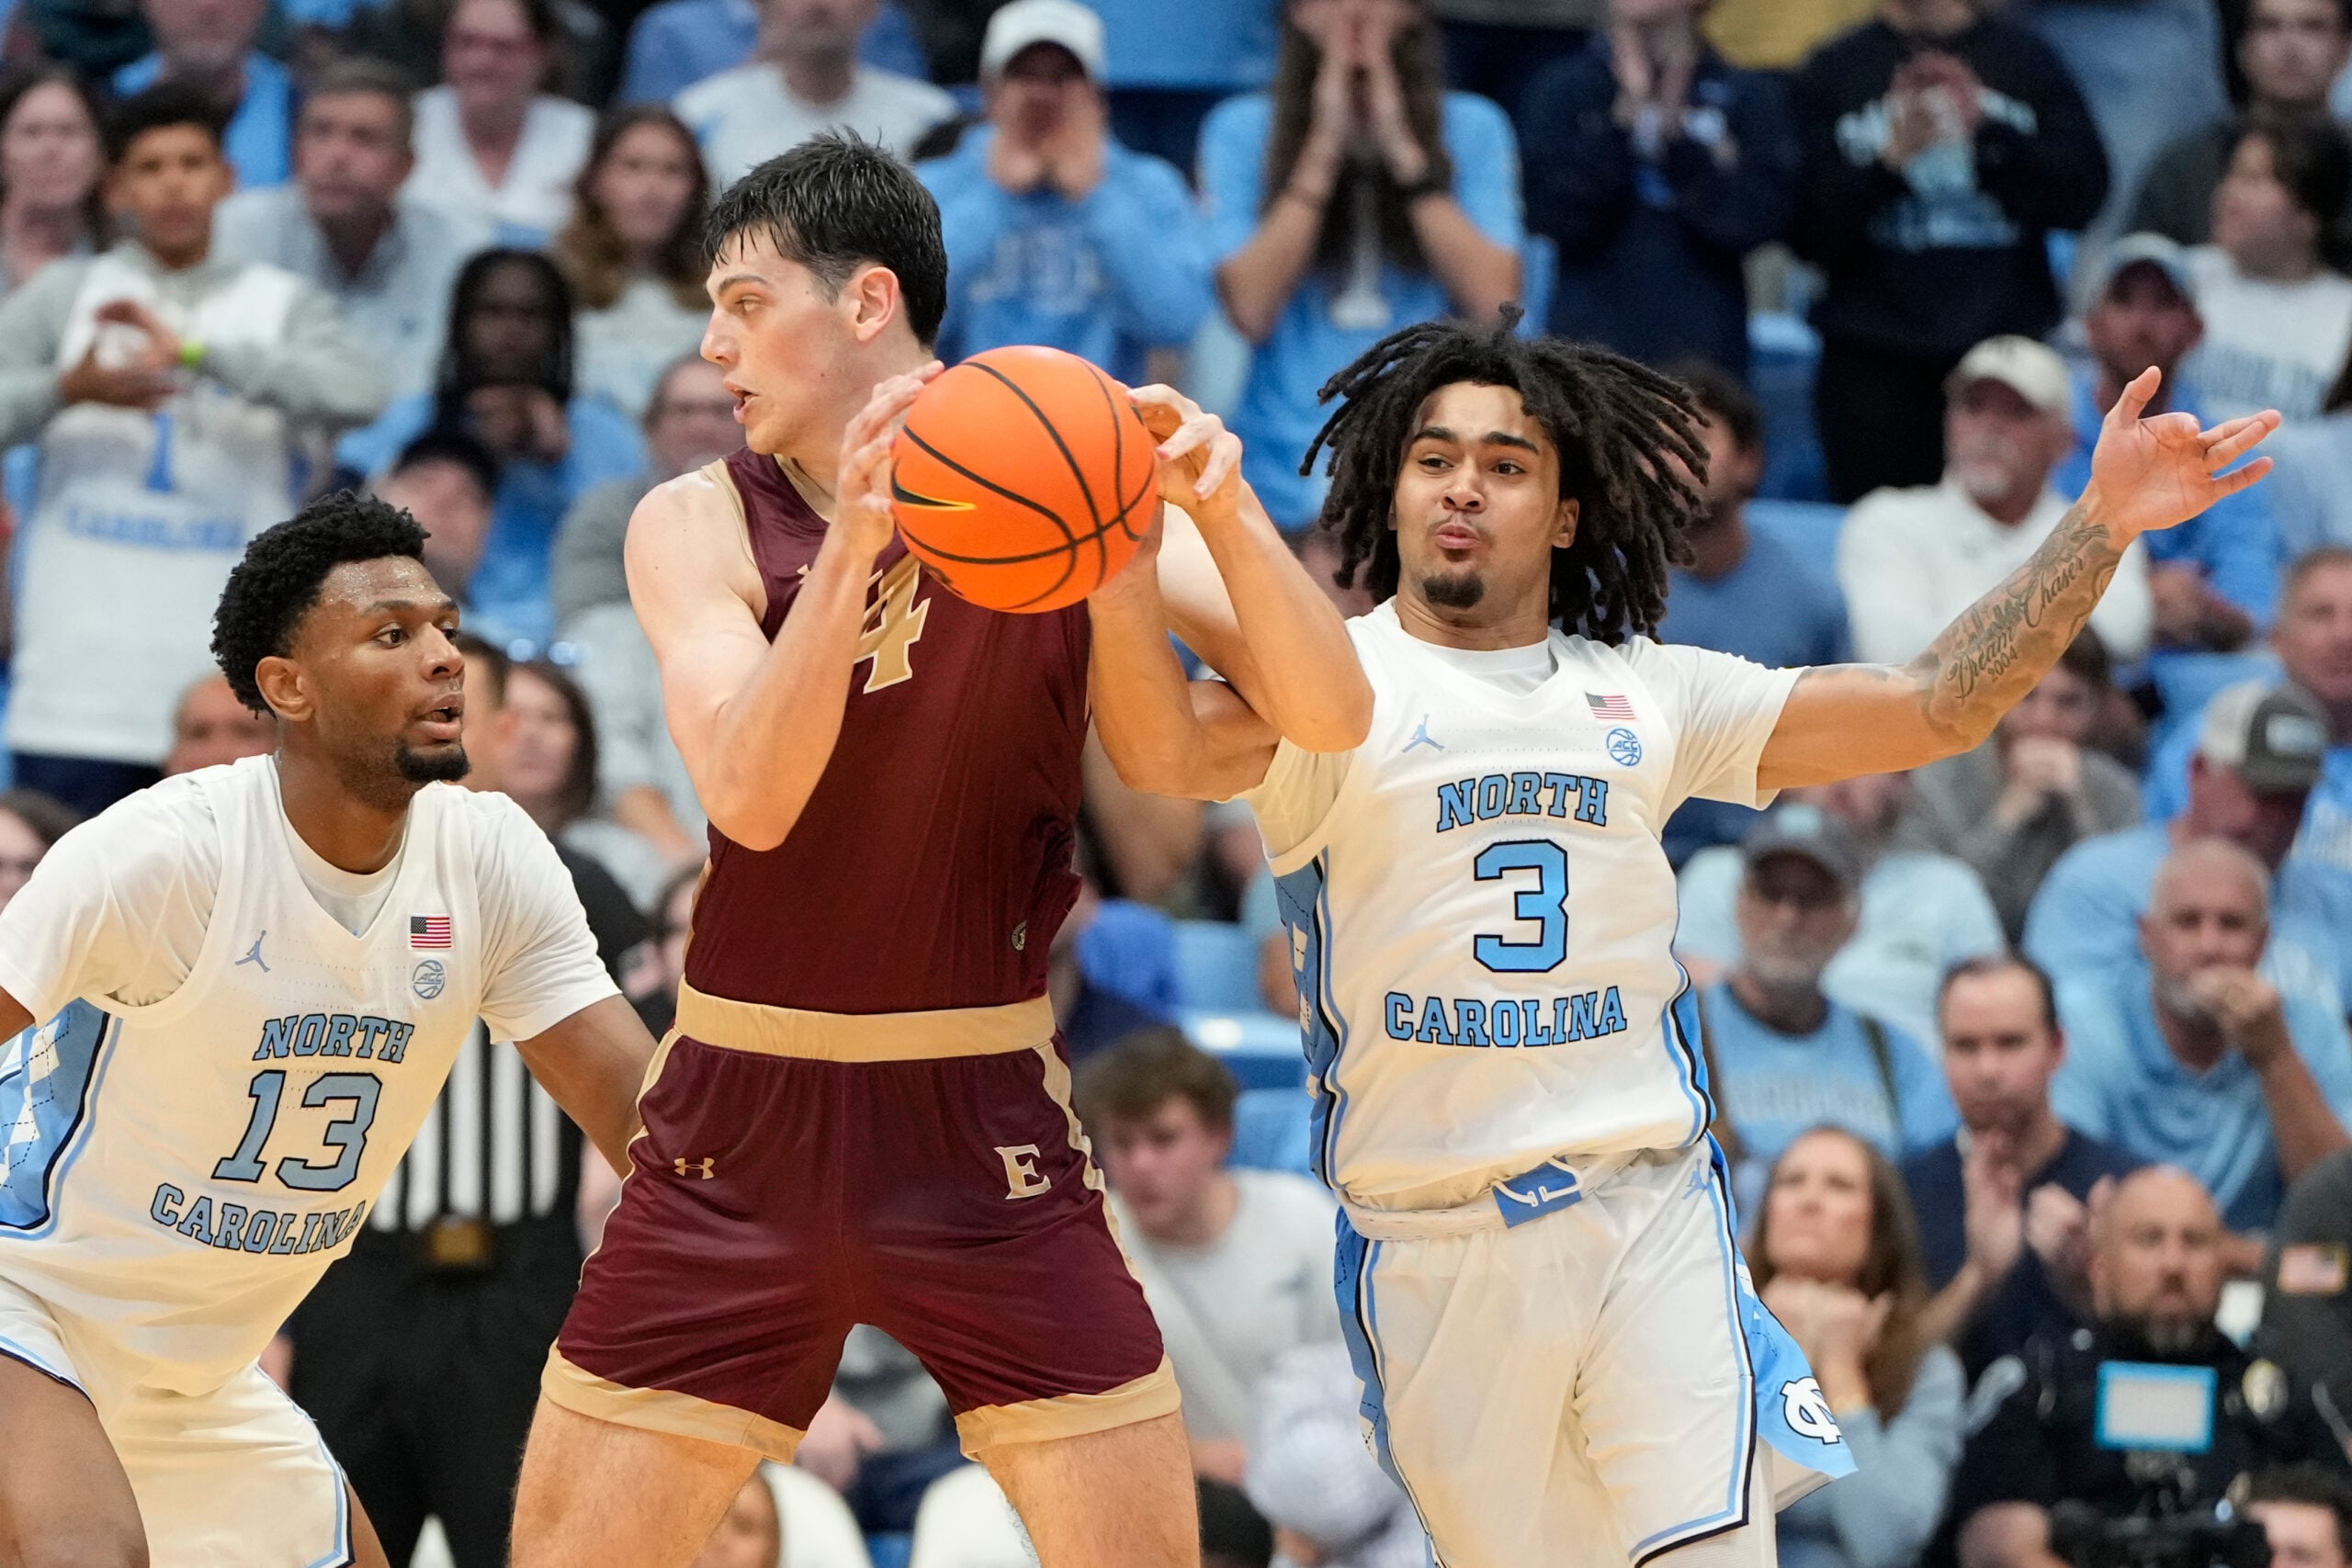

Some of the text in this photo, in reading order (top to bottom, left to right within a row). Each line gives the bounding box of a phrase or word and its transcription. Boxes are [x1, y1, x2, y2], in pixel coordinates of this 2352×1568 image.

[1987, 646, 2018, 682] 2004
[1612, 740, 1638, 750] ACC
[1436, 772, 1608, 832] NORTH
[1474, 840, 1568, 973] 3
[252, 1013, 415, 1064] NORTH
[1385, 986, 1627, 1048] CAROLINA
[210, 1069, 383, 1191] 13
[993, 1144, 1052, 1200] E
[150, 1183, 367, 1255] CAROLINA
